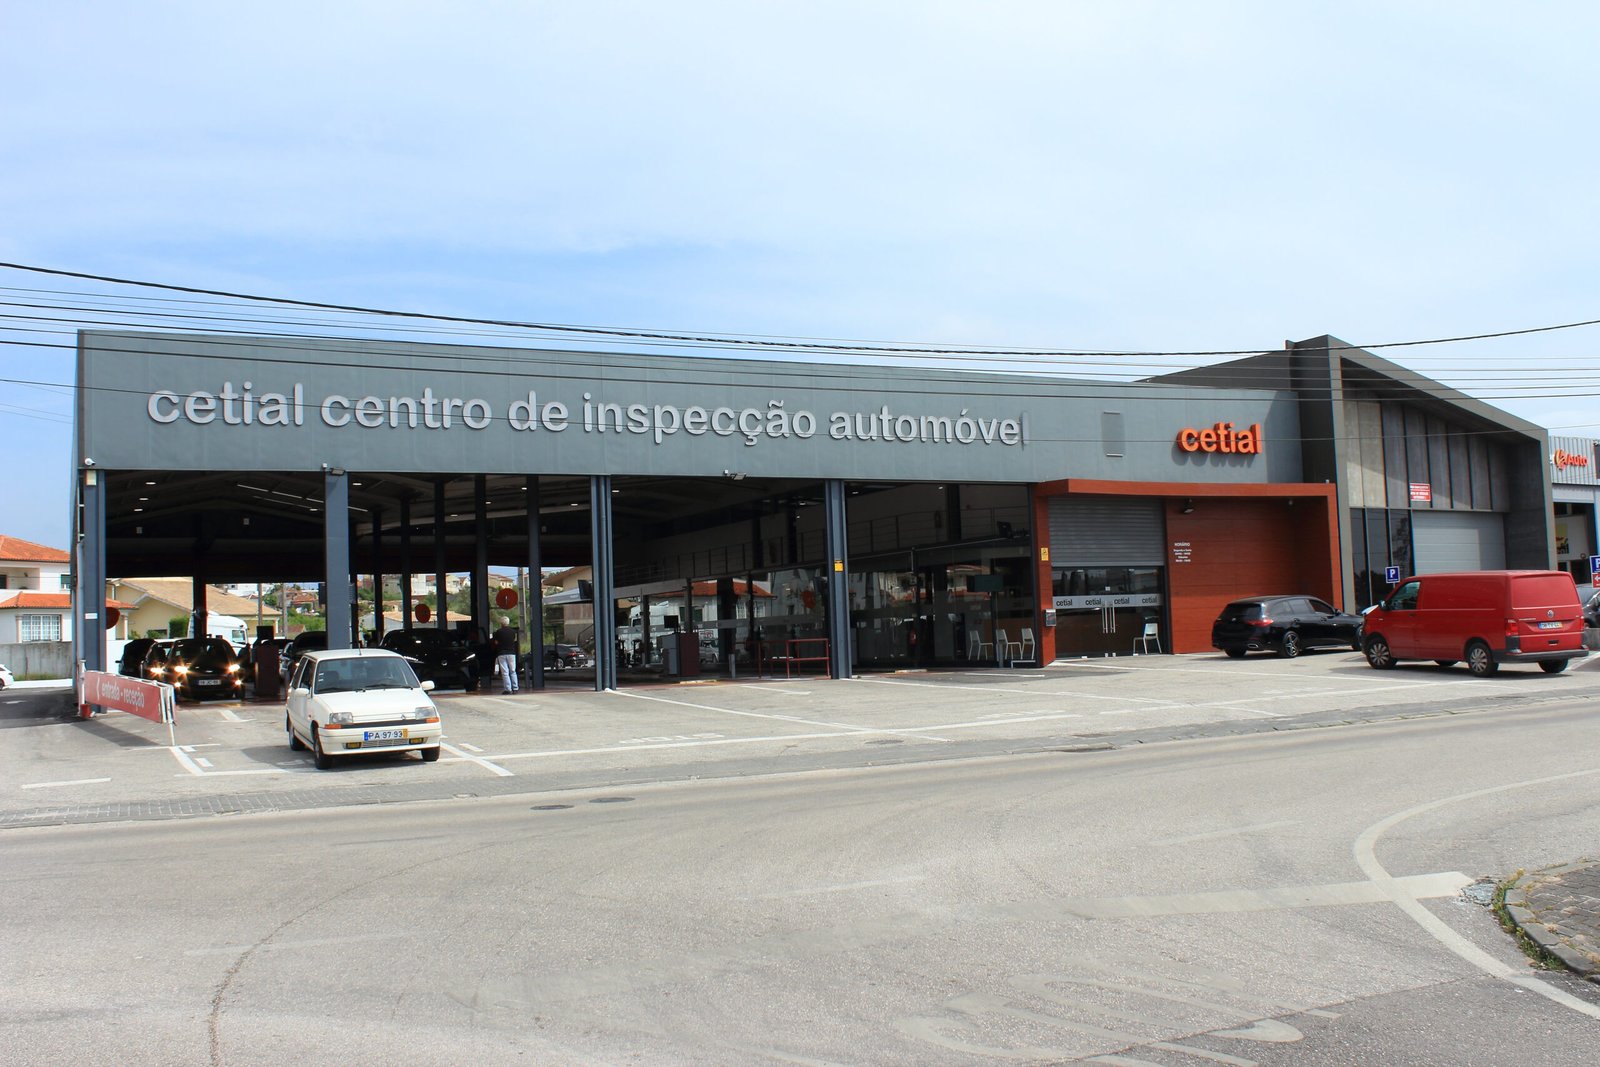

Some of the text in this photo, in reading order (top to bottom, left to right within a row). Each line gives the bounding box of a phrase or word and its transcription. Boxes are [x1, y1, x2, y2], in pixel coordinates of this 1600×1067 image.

[148, 381, 1030, 447] cetial centro de inspecção automóvel
[1177, 421, 1262, 454] cetial
[1390, 569, 1396, 578] P
[1085, 598, 1102, 606] cetial
